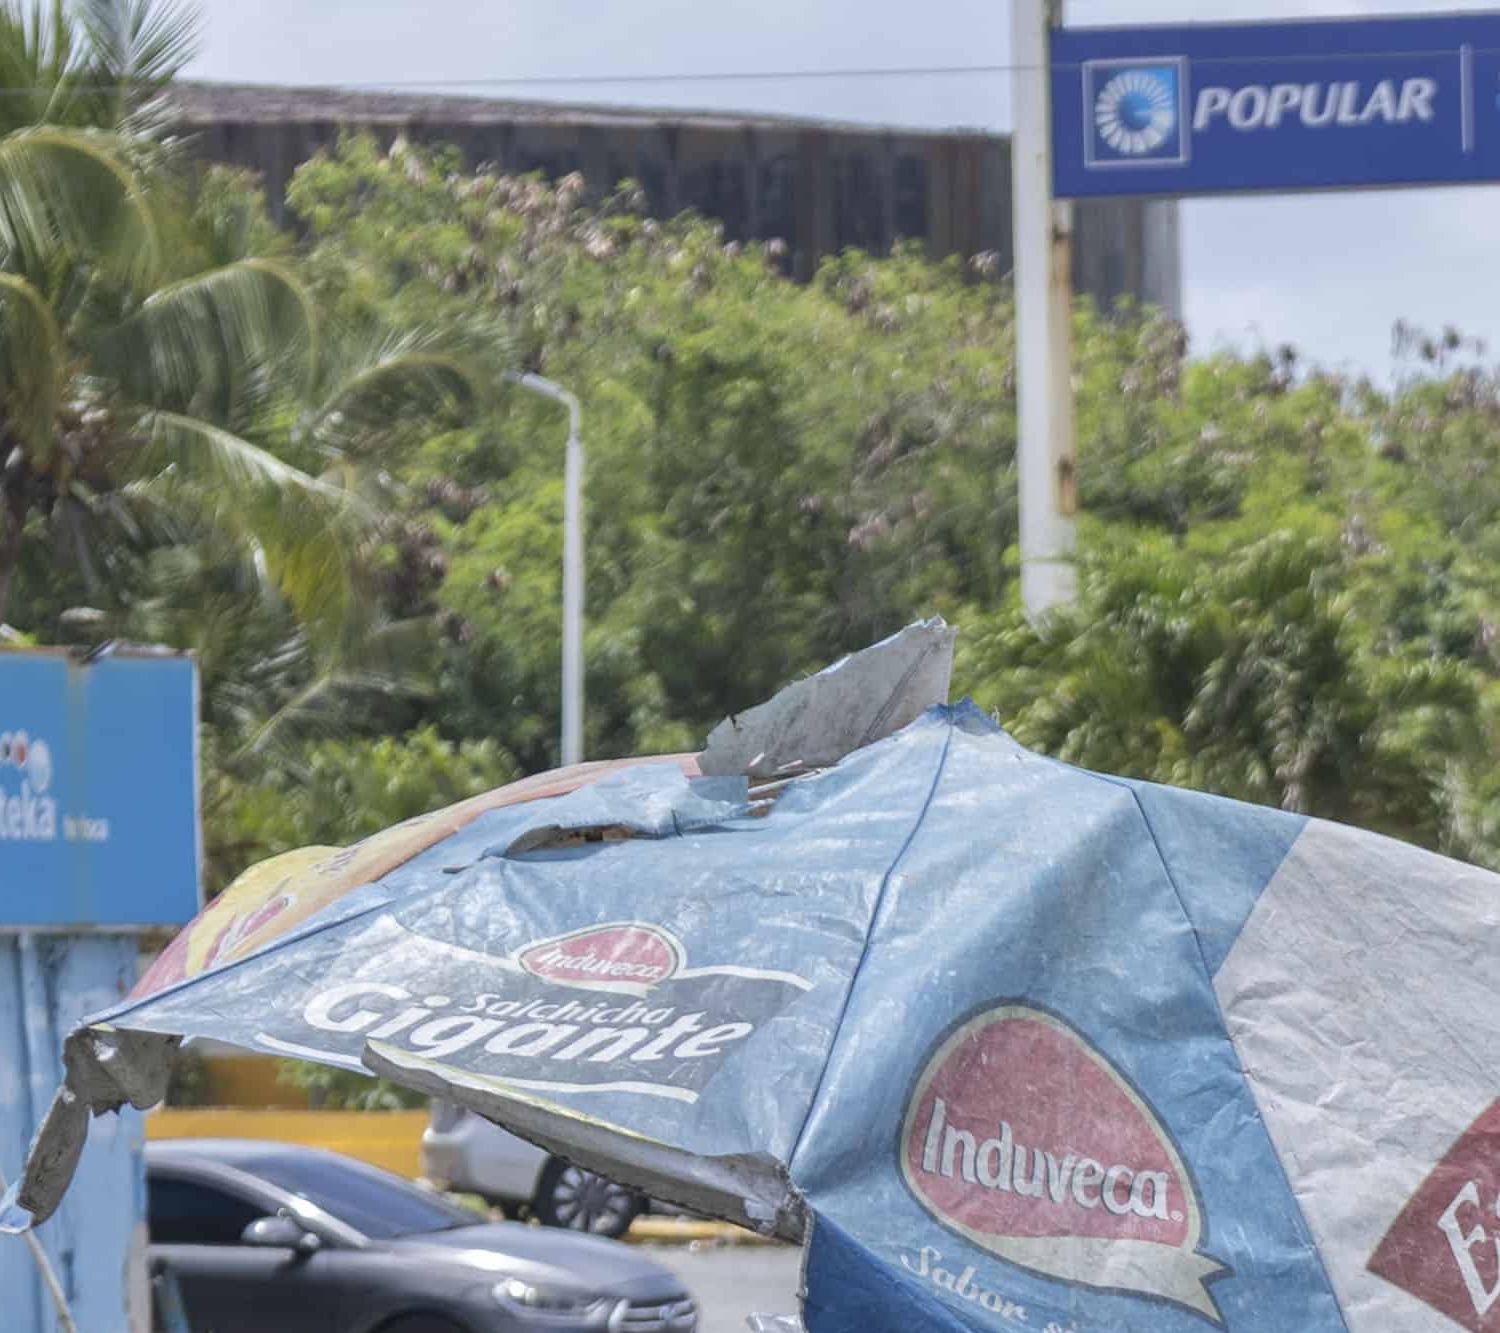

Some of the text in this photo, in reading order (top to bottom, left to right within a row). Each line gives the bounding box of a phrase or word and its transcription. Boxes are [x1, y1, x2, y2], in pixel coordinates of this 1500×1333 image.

[1194, 78, 1437, 130] POPULAR
[535, 947, 663, 979] Induveca
[304, 982, 753, 1062] Gigante
[460, 993, 675, 1024] Salchicha
[921, 1098, 1171, 1221] Induveca
[901, 1245, 1029, 1322] Sabor
